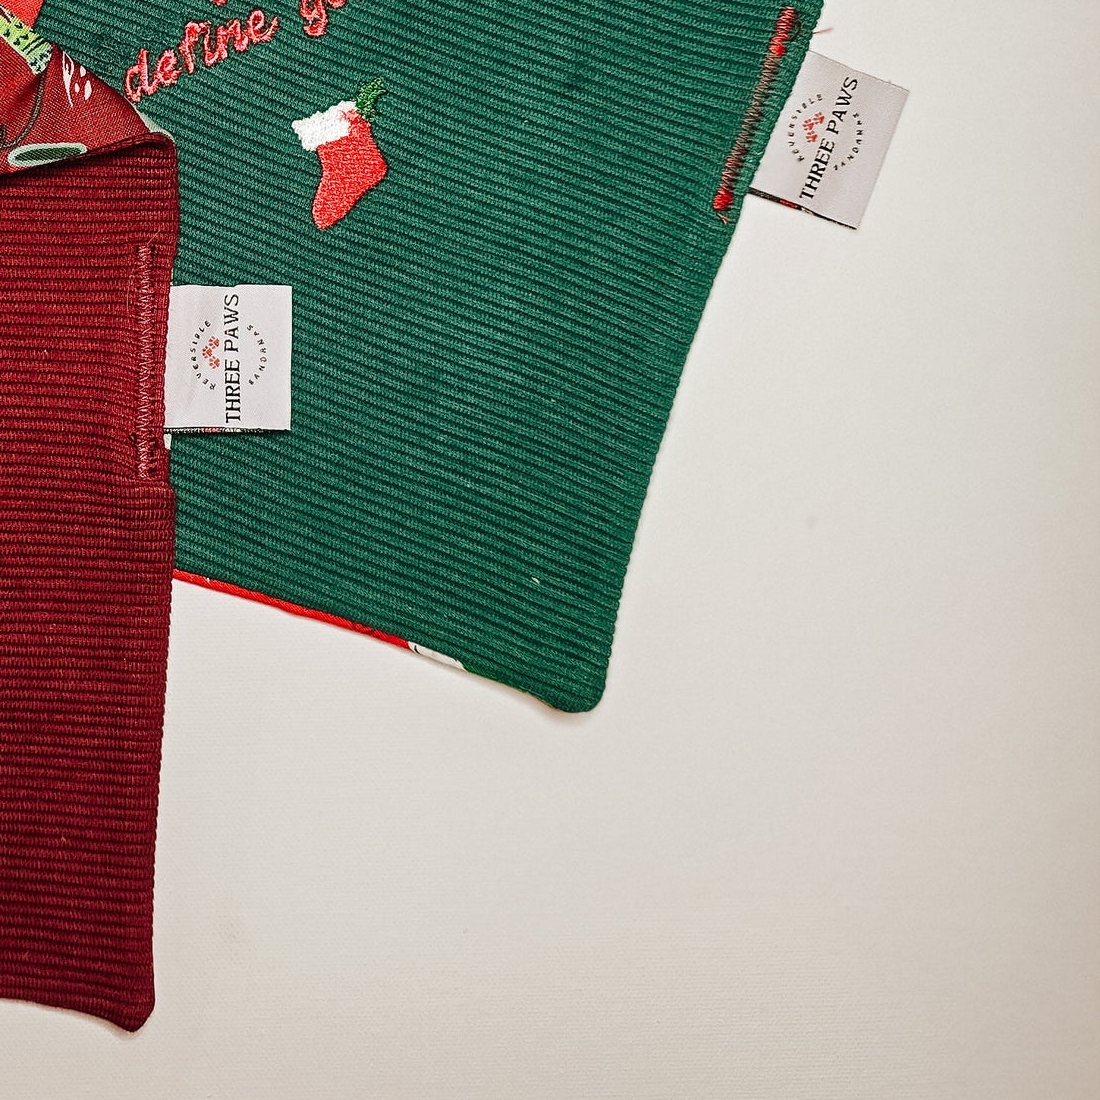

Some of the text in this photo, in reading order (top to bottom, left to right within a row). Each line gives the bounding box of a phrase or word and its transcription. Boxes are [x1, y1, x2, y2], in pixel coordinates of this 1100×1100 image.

[799, 76, 858, 199] THREE PAWS
[190, 320, 216, 390] REVERSIBLE
[223, 293, 241, 423] THREE PAWS
[246, 324, 267, 385] BANDANAS
